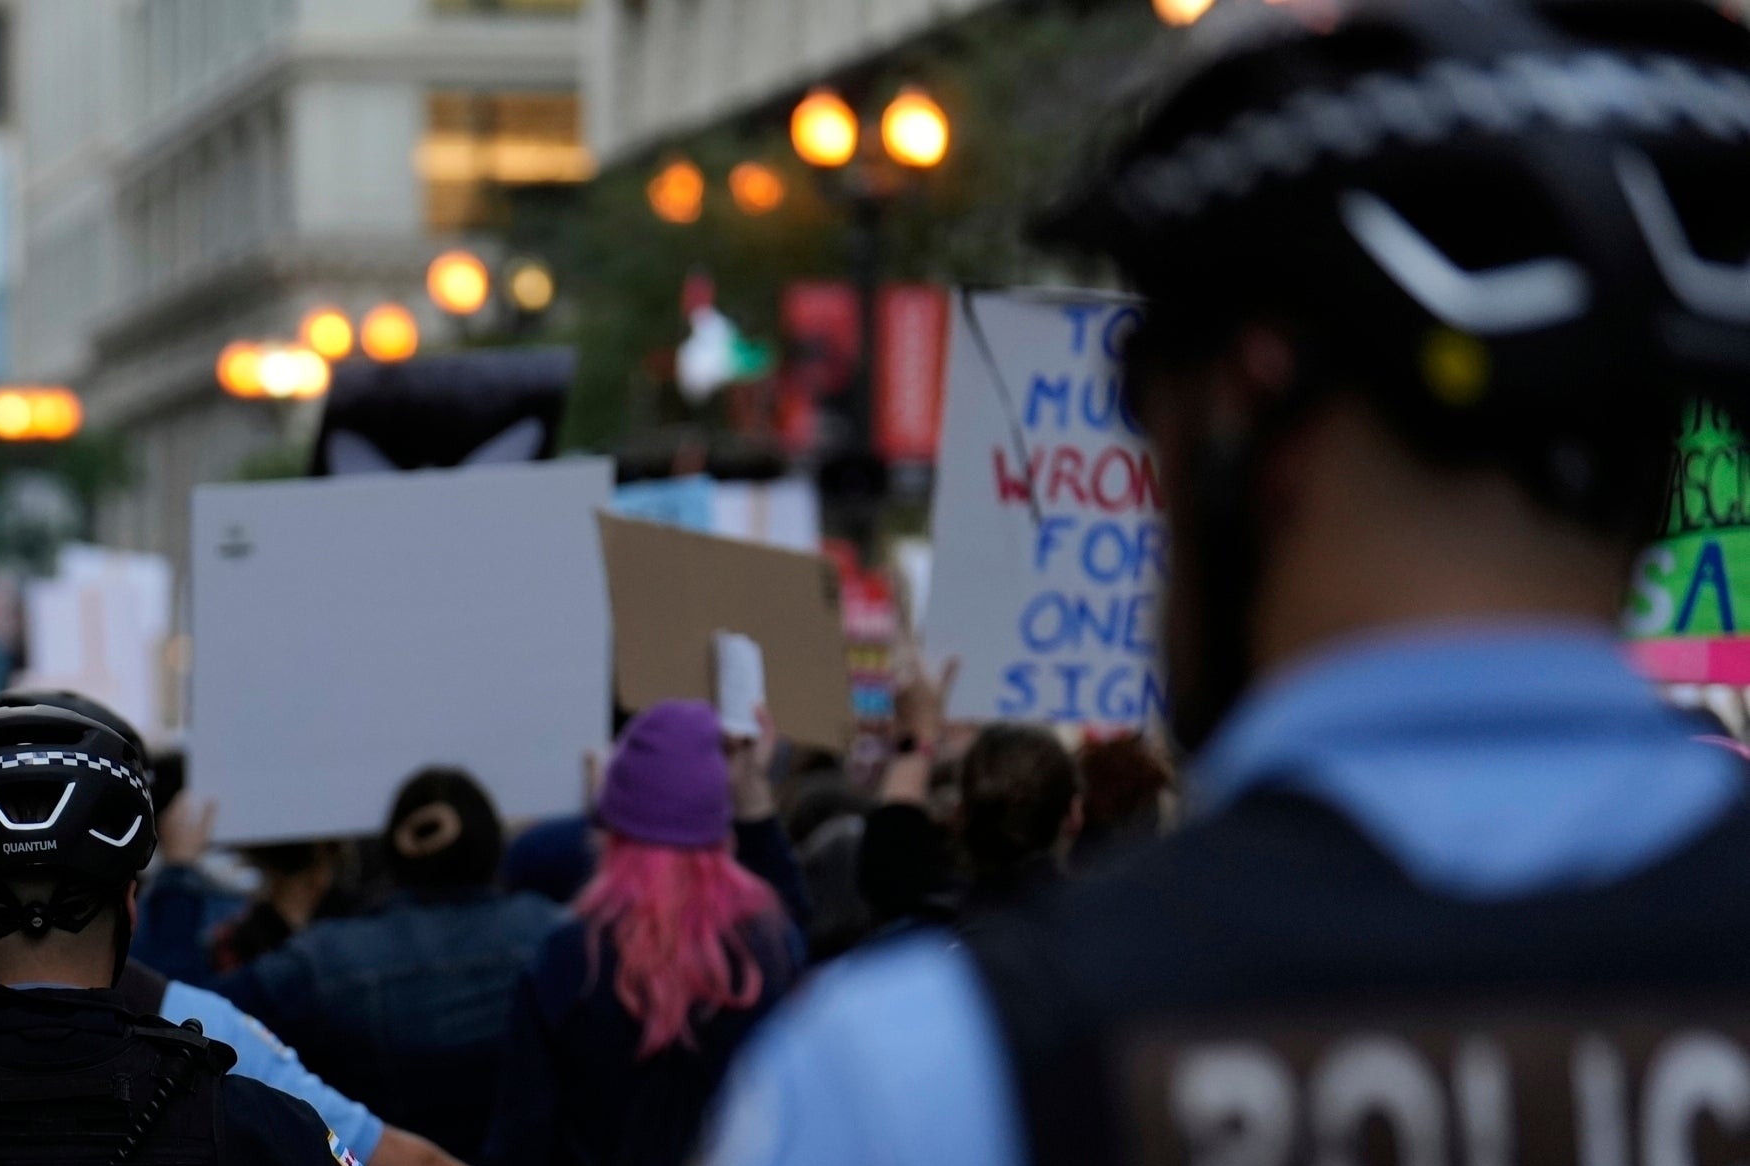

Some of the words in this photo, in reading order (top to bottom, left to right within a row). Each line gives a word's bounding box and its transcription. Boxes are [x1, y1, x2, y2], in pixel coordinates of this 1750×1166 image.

[1034, 516, 1172, 583] FOR
[1019, 592, 1156, 654] ONE
[3, 840, 57, 855] QUANTUM
